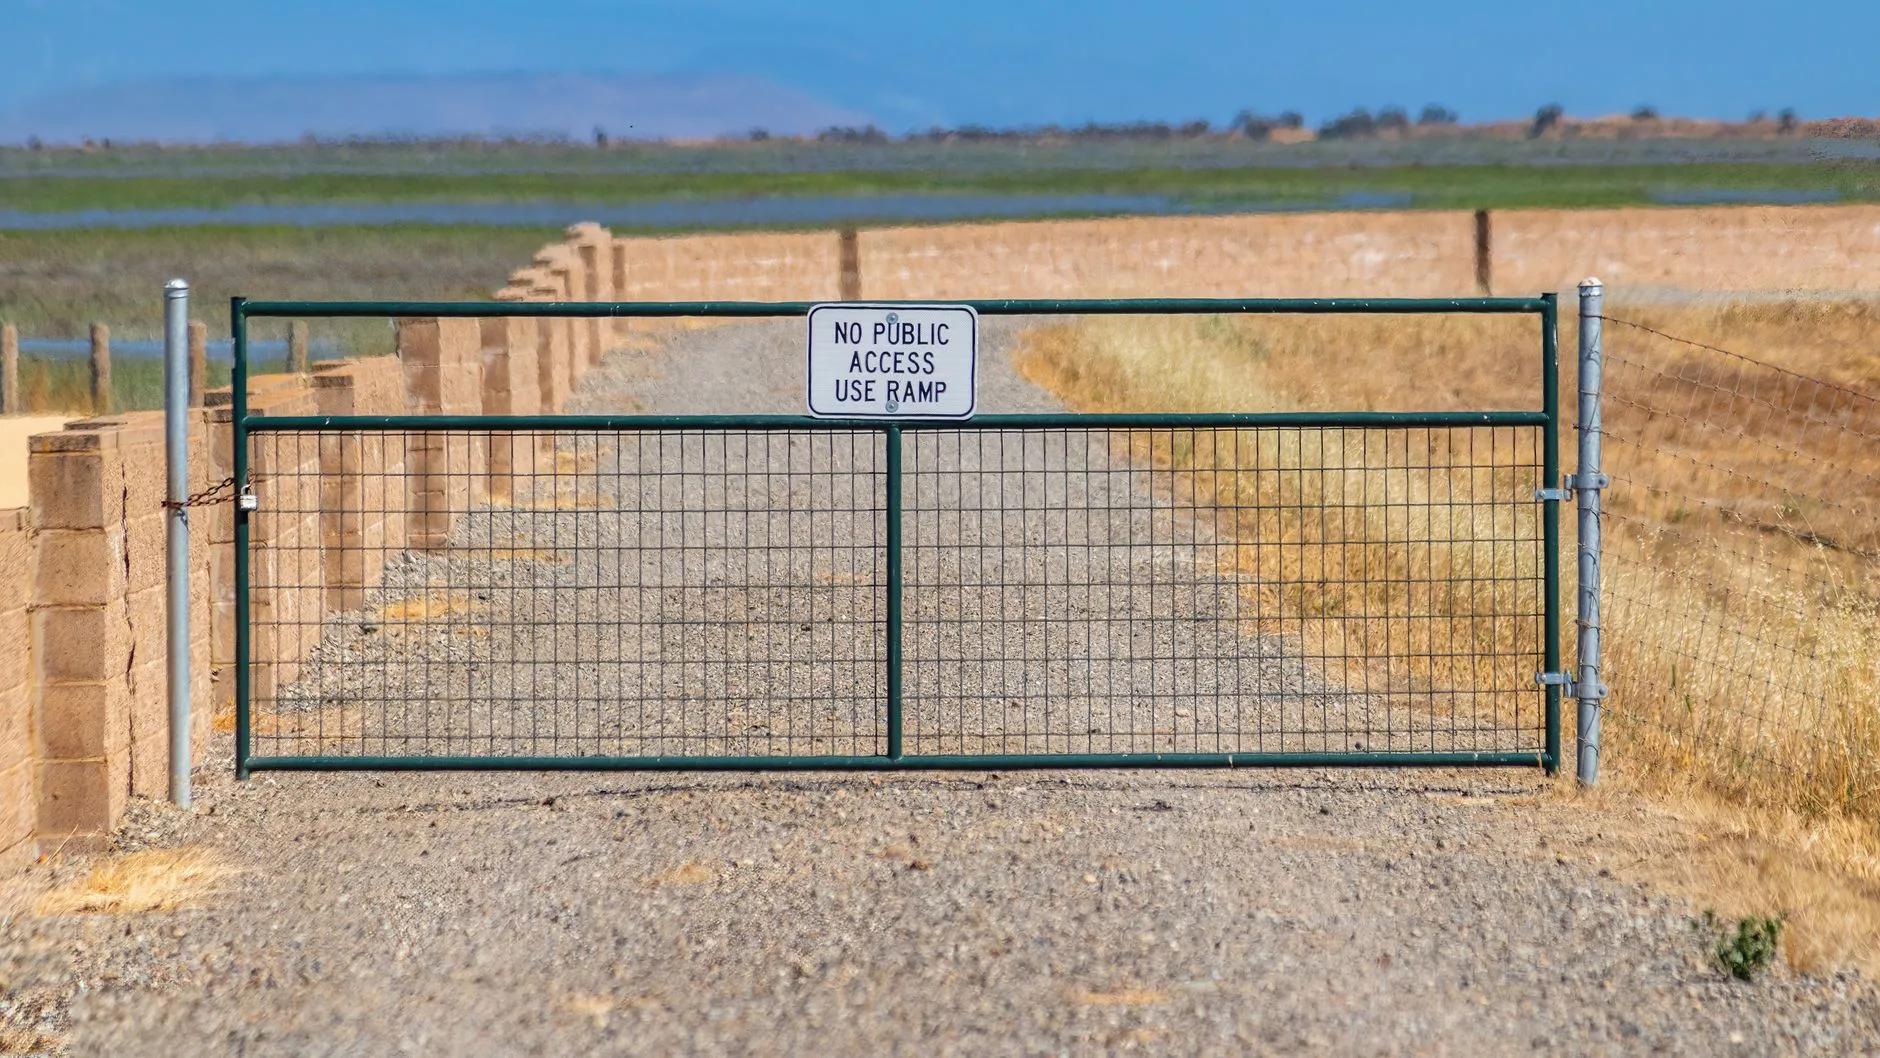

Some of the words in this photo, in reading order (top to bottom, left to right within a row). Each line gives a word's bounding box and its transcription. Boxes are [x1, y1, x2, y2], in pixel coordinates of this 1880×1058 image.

[834, 321, 863, 345] NO
[873, 321, 950, 346] PUBLIC
[849, 350, 935, 375] ACCESS
[835, 378, 876, 402] USE
[886, 379, 947, 403] RAMP
